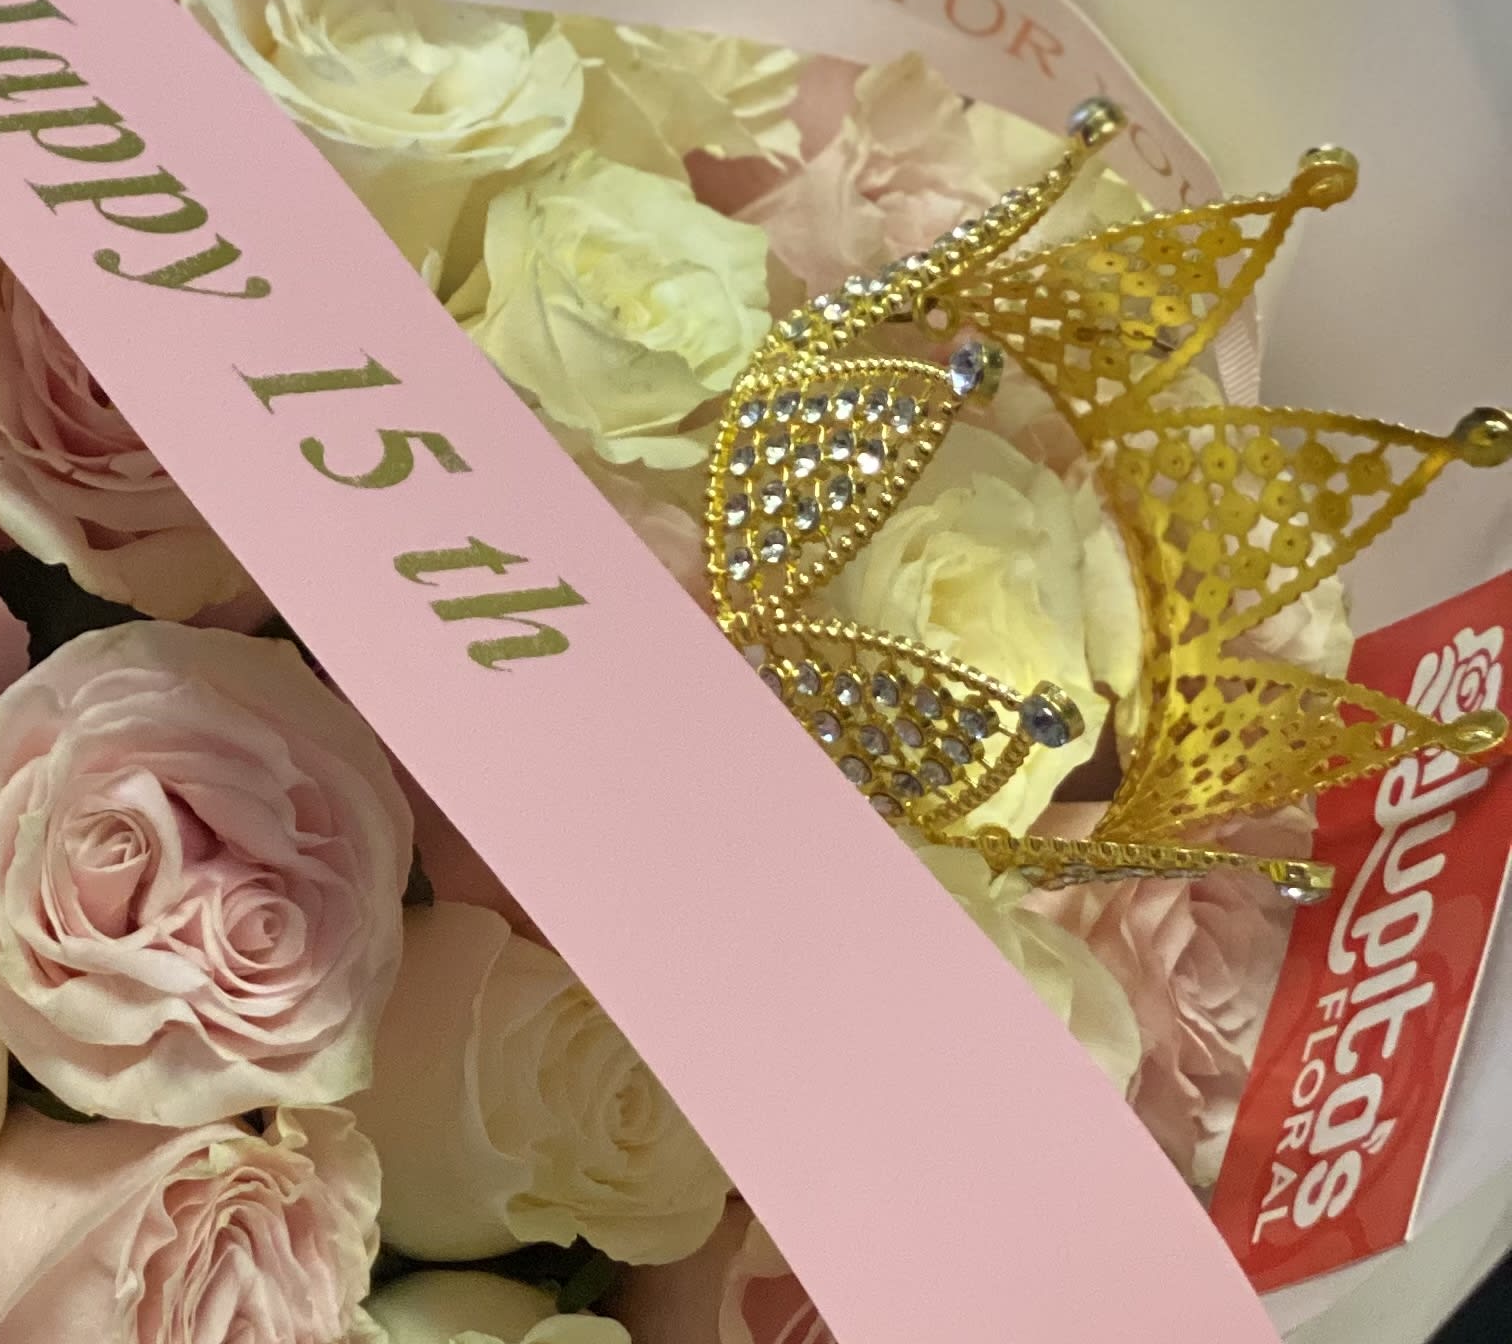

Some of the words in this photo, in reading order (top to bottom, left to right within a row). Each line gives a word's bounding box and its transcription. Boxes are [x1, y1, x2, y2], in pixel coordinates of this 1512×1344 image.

[231, 348, 473, 490] 15
[392, 536, 590, 673] th
[1250, 994, 1343, 1246] FLORAL
